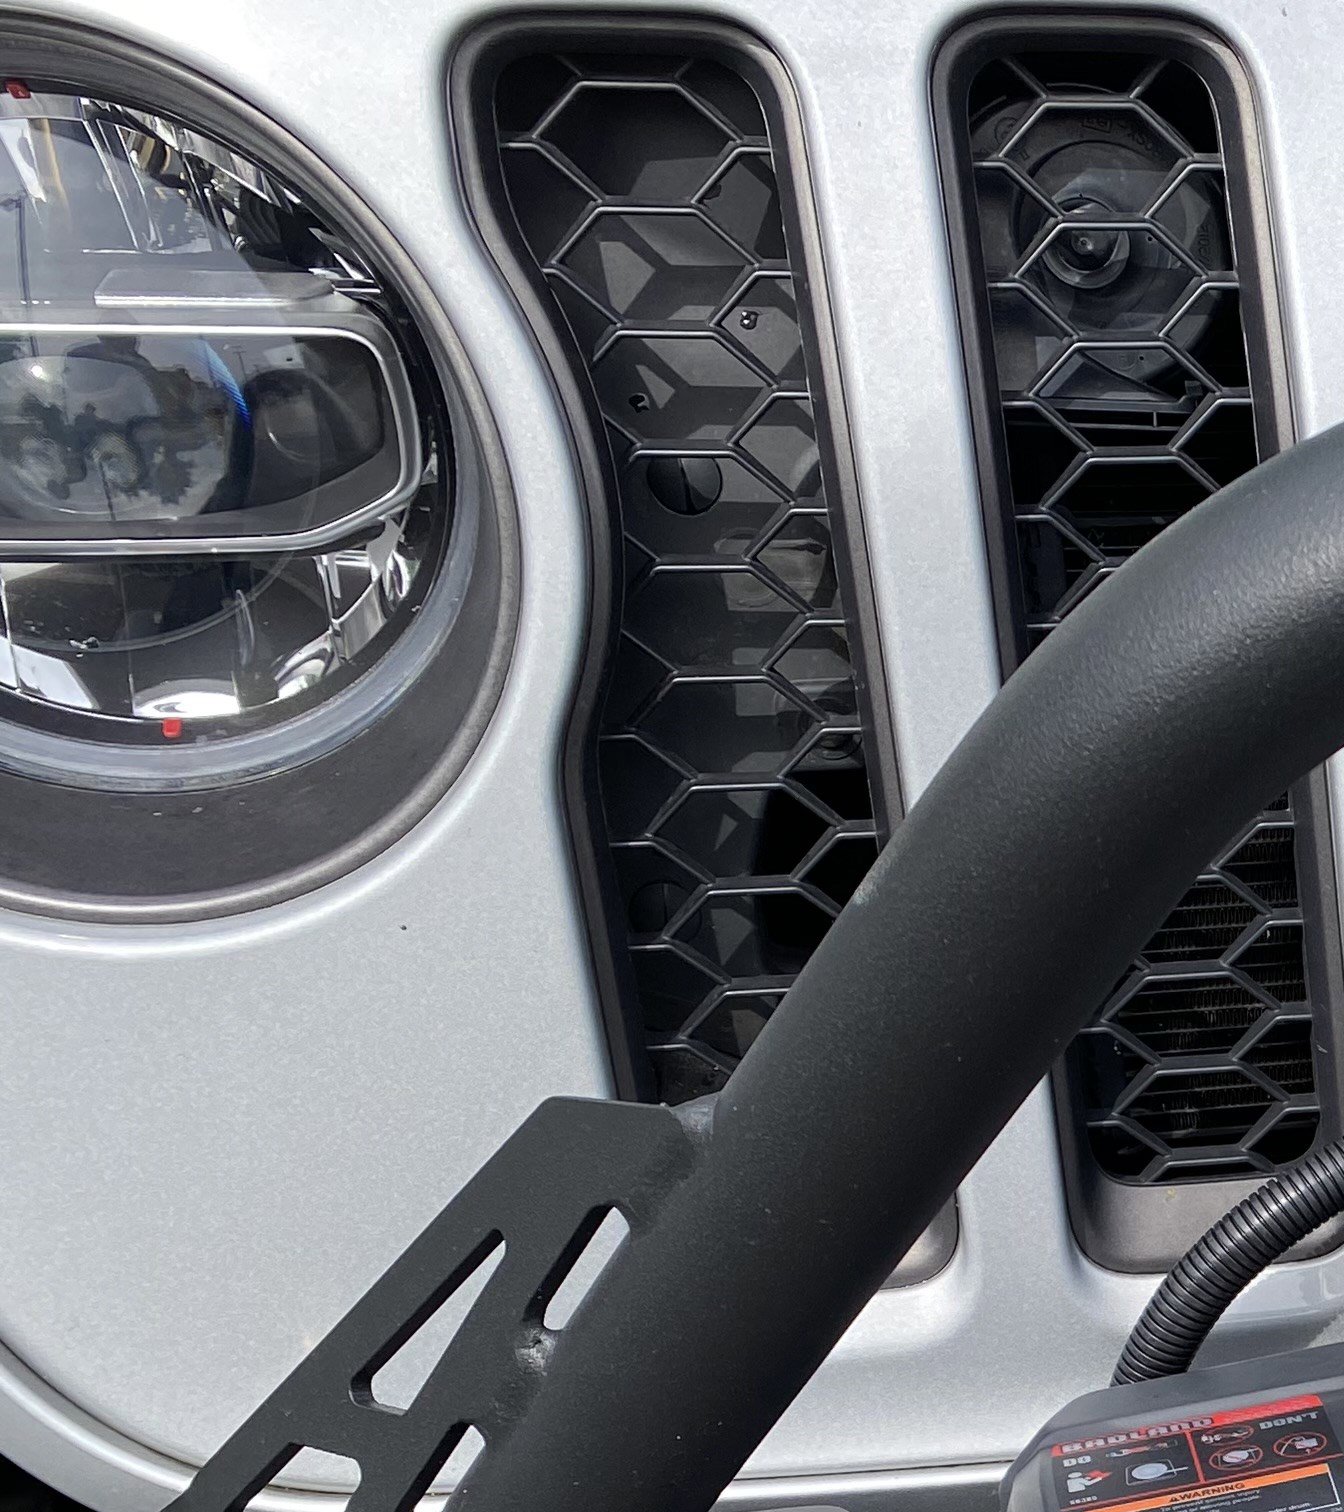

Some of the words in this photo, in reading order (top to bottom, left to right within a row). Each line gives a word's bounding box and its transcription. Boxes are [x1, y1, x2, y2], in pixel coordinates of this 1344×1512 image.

[1260, 1411, 1318, 1430] DON'T
[1062, 1418, 1212, 1453] BADLAND
[1063, 1455, 1091, 1467] DO
[1179, 1483, 1245, 1500] WARNING
